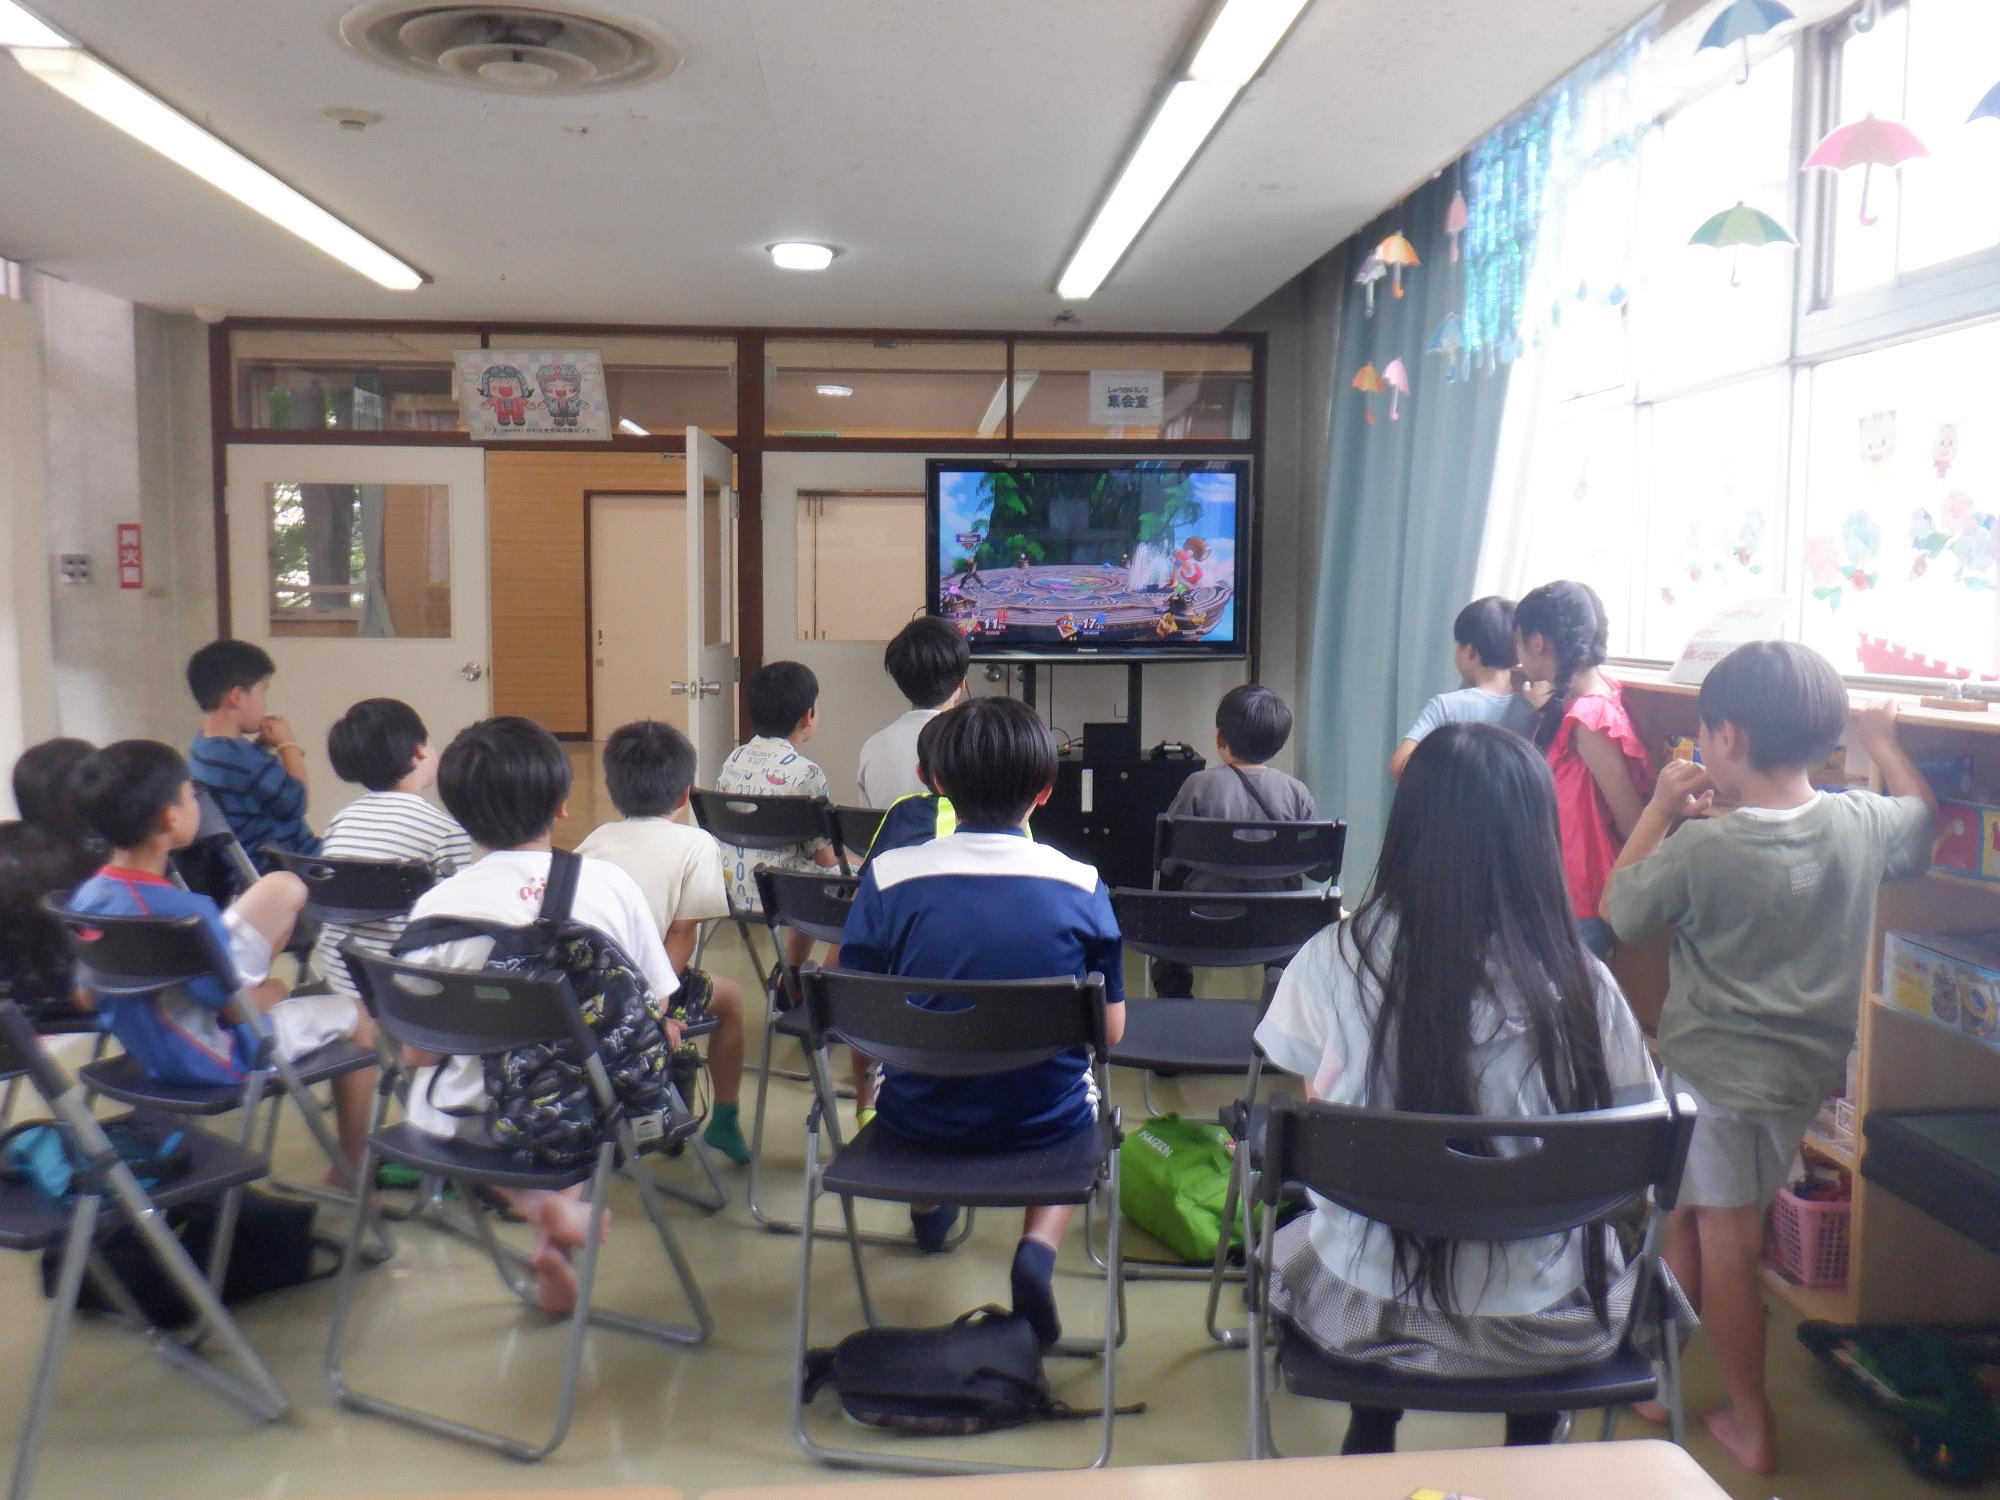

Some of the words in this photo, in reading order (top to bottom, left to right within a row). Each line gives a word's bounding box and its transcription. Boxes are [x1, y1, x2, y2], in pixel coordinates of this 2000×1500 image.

[1107, 394, 1149, 409] 集会室
[1138, 1130, 1174, 1158] MAIZEN
